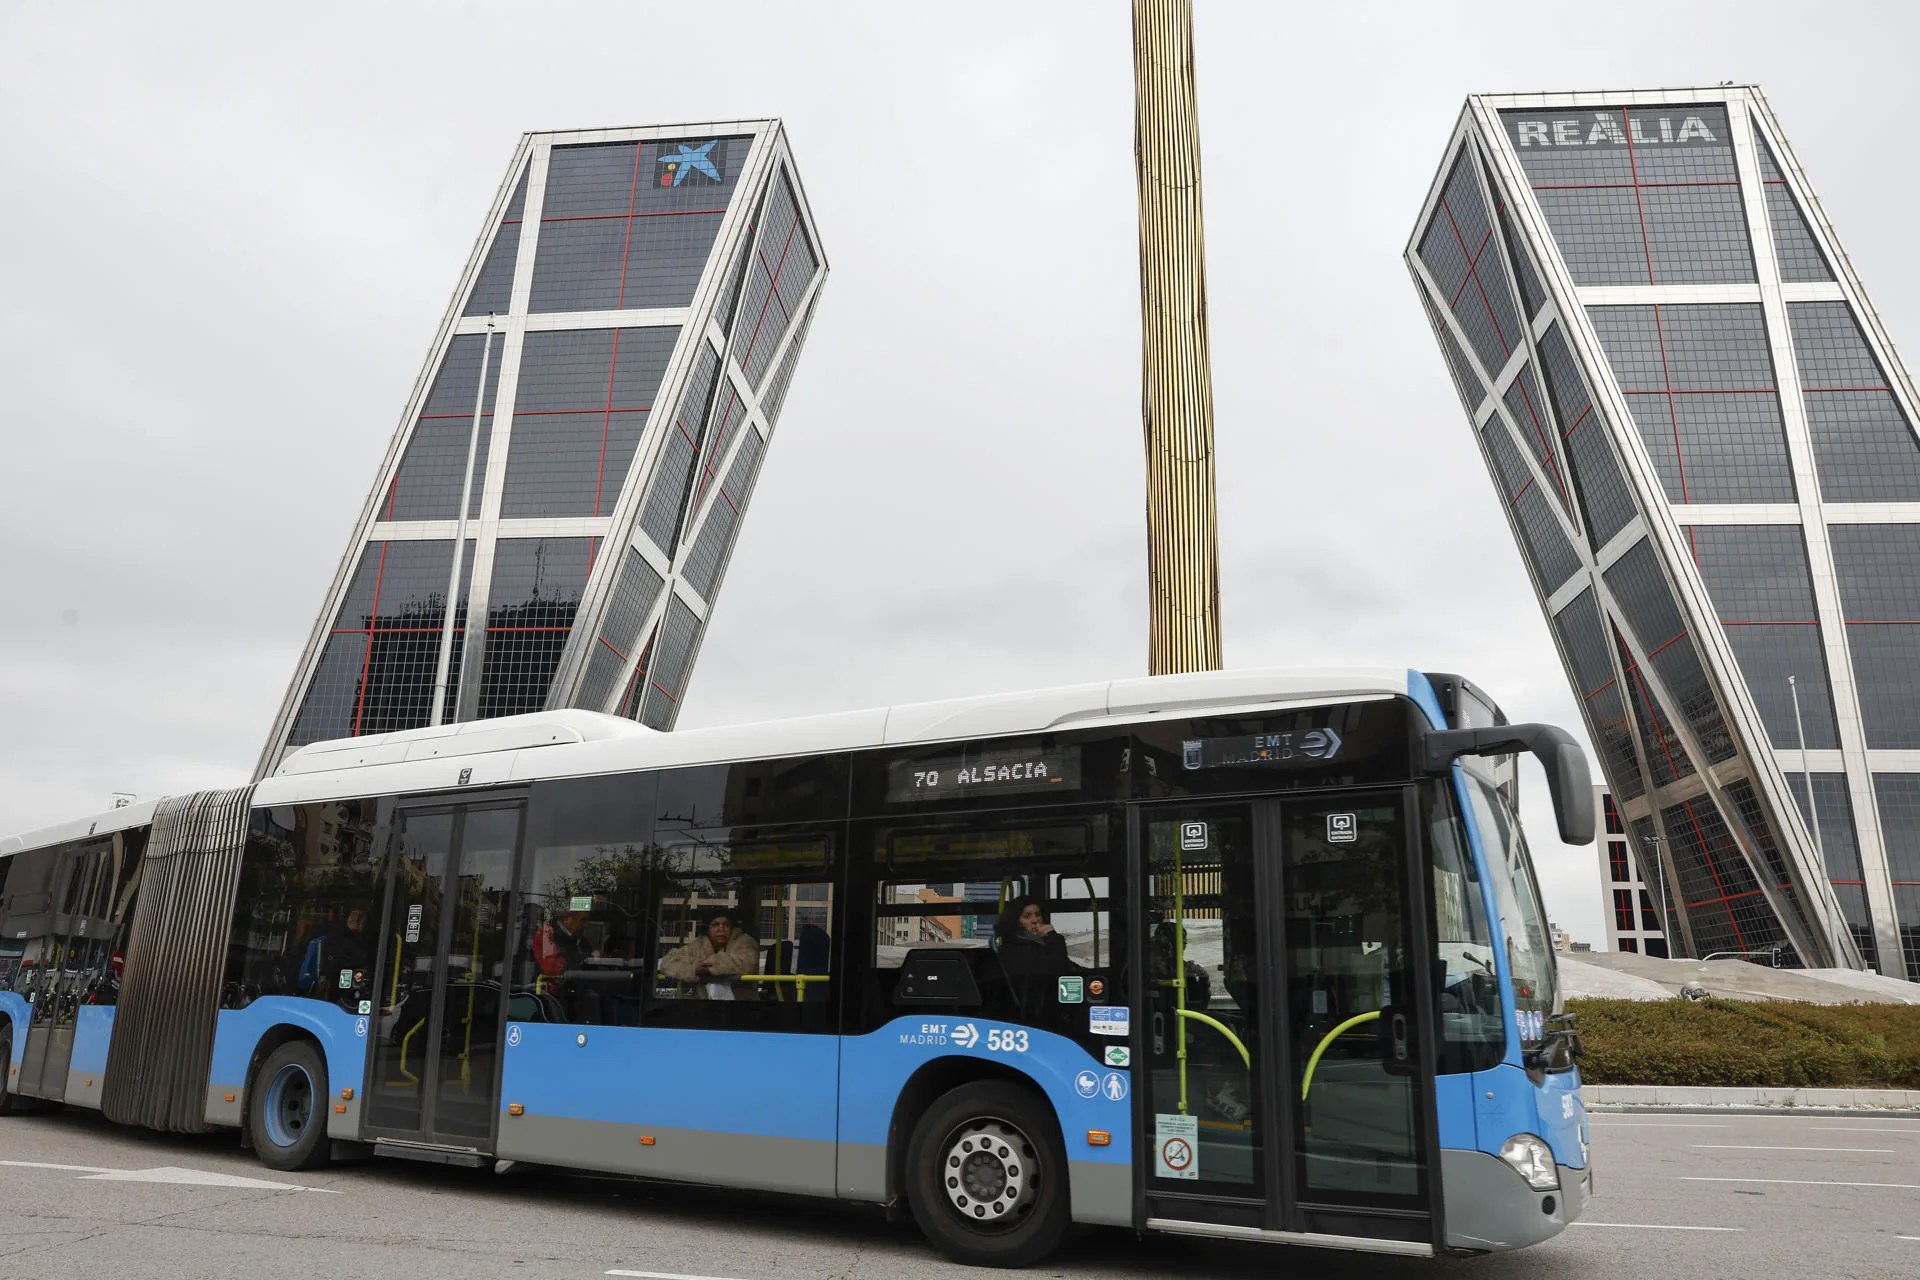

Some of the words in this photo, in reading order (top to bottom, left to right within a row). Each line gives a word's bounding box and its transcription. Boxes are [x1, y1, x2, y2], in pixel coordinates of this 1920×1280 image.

[1516, 113, 1717, 147] REALIA
[1255, 734, 1292, 748] EMT
[914, 771, 939, 787] 70
[957, 762, 1048, 784] ALSACIA
[921, 1024, 947, 1034] EMT
[900, 1034, 947, 1046] MADRID
[987, 1029, 1029, 1052] 583
